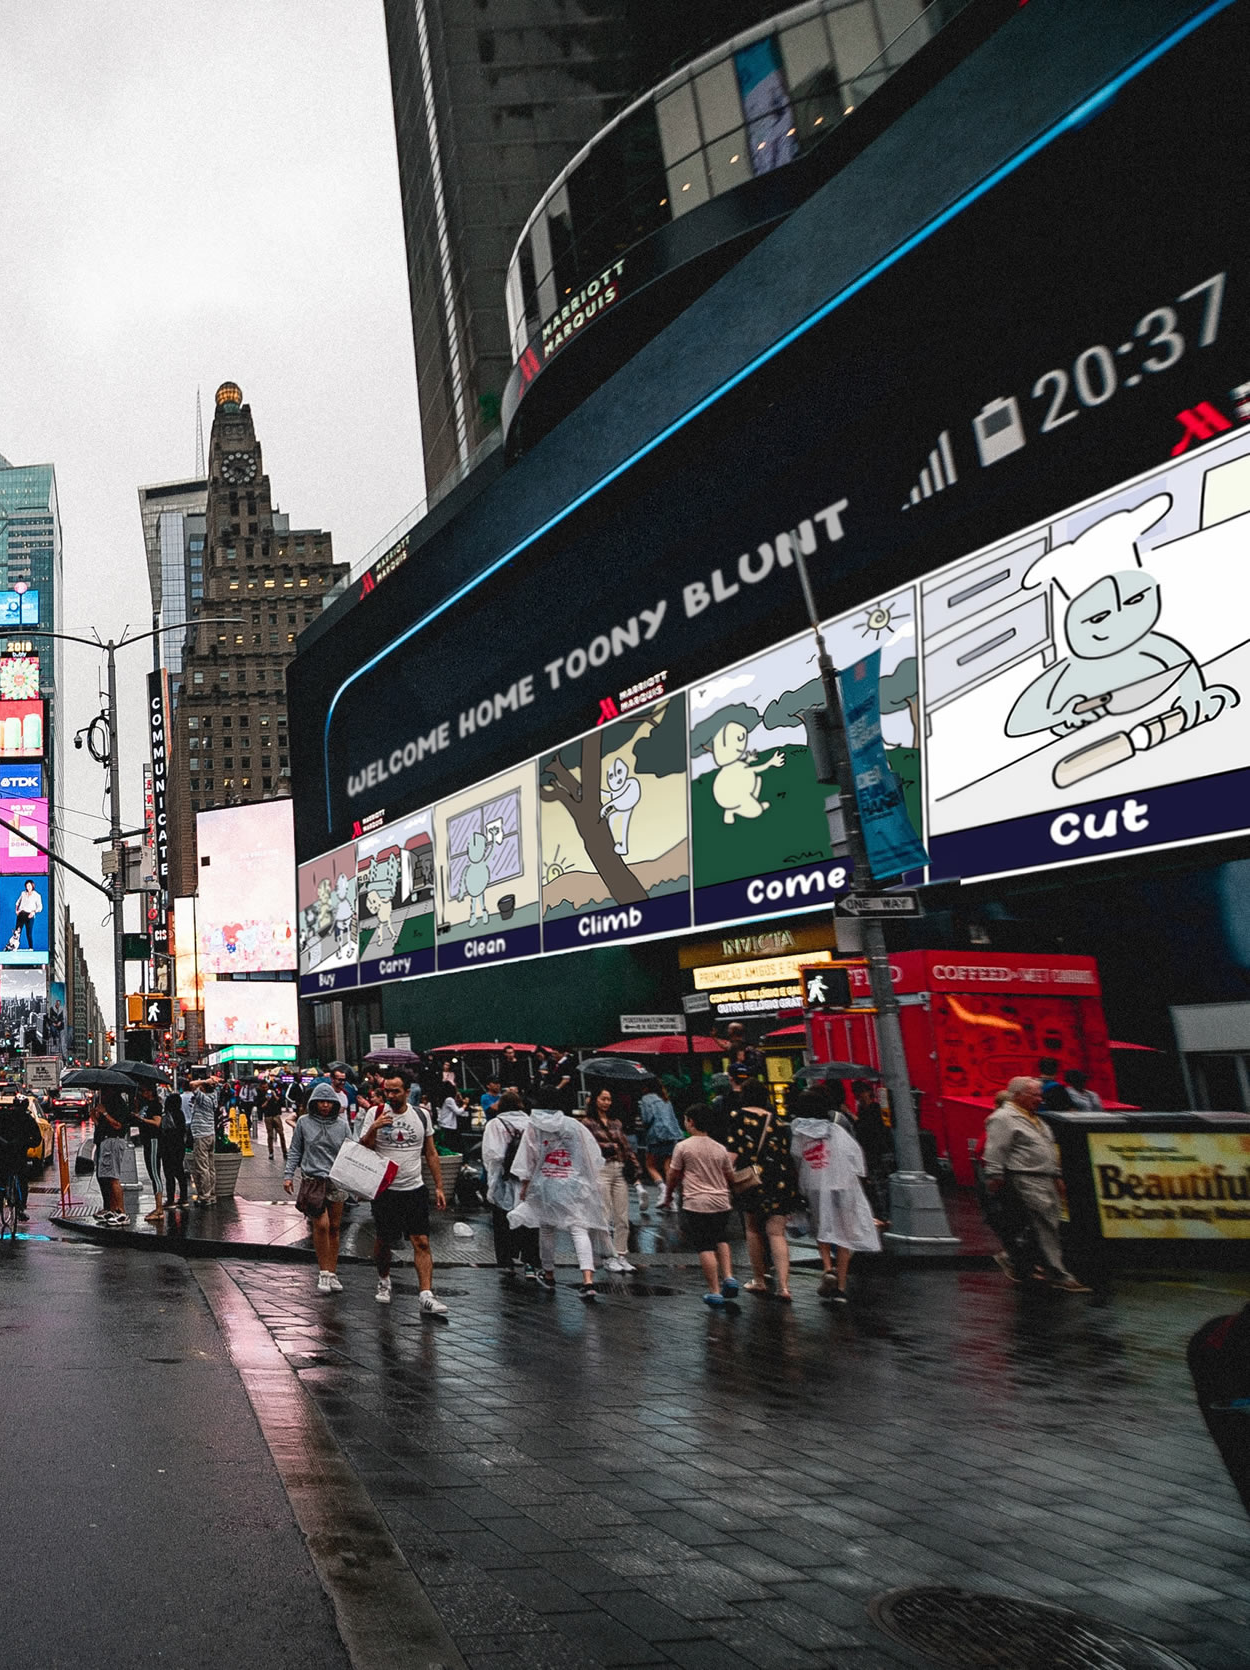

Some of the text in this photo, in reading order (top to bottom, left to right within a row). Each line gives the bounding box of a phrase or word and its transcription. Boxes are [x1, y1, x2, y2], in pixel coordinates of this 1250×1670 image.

[542, 259, 625, 341] MARRIOTT
[544, 286, 617, 359] MARQUIS
[1030, 272, 1227, 433] 20:37
[347, 498, 848, 798] WELCOME HOME TOONY BLUNT
[618, 670, 668, 700] MARRIOTT
[620, 684, 665, 713] MARQUIS
[10, 777, 38, 788] TDK
[151, 697, 169, 876] COMMUNICATE
[879, 896, 913, 910] WAY
[578, 907, 643, 937] Climb
[464, 938, 506, 958] Clean
[722, 930, 795, 957] INVICTA
[319, 971, 335, 987] Buy
[379, 957, 412, 975] Carry
[932, 965, 1012, 982] COFFEED
[717, 1002, 743, 1014] OUTRO
